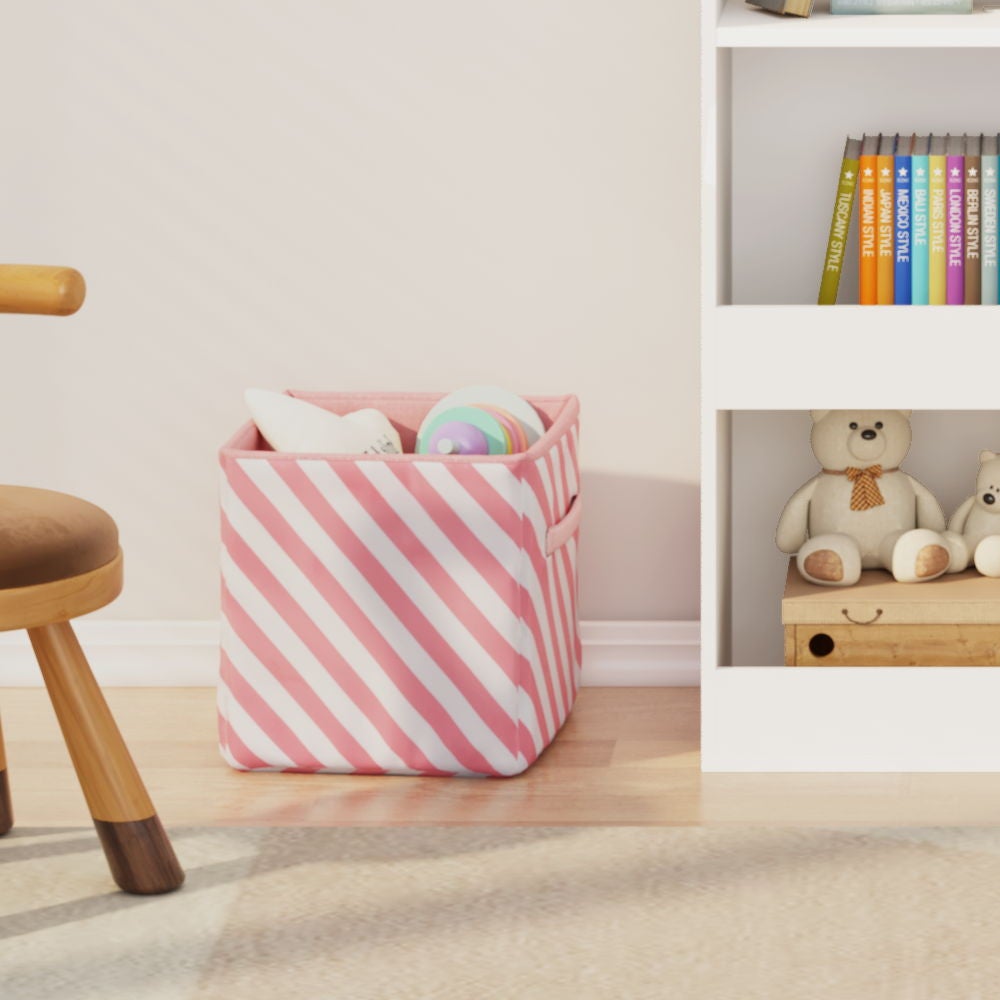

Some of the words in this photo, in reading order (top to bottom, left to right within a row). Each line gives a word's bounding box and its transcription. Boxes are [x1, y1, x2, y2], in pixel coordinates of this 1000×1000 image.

[833, 192, 853, 239] TUSCANY
[863, 189, 874, 223] INDIAN
[880, 189, 892, 222] JAPAN
[897, 189, 910, 228] MEXICO
[915, 189, 927, 212] BALI
[932, 189, 944, 219] PARIS
[950, 189, 961, 233] LONDON
[967, 189, 979, 225] BERLIN
[985, 189, 996, 233] SWEDEN
[863, 226, 874, 257] STYLE
[879, 225, 892, 256] STYLE
[914, 215, 927, 245] STYLE
[932, 221, 944, 253] STYLE
[967, 227, 979, 258] STYLE
[827, 241, 842, 271] STYLE
[897, 231, 910, 262] STYLE
[949, 235, 961, 266] STYLE
[984, 235, 996, 266] STYLE
